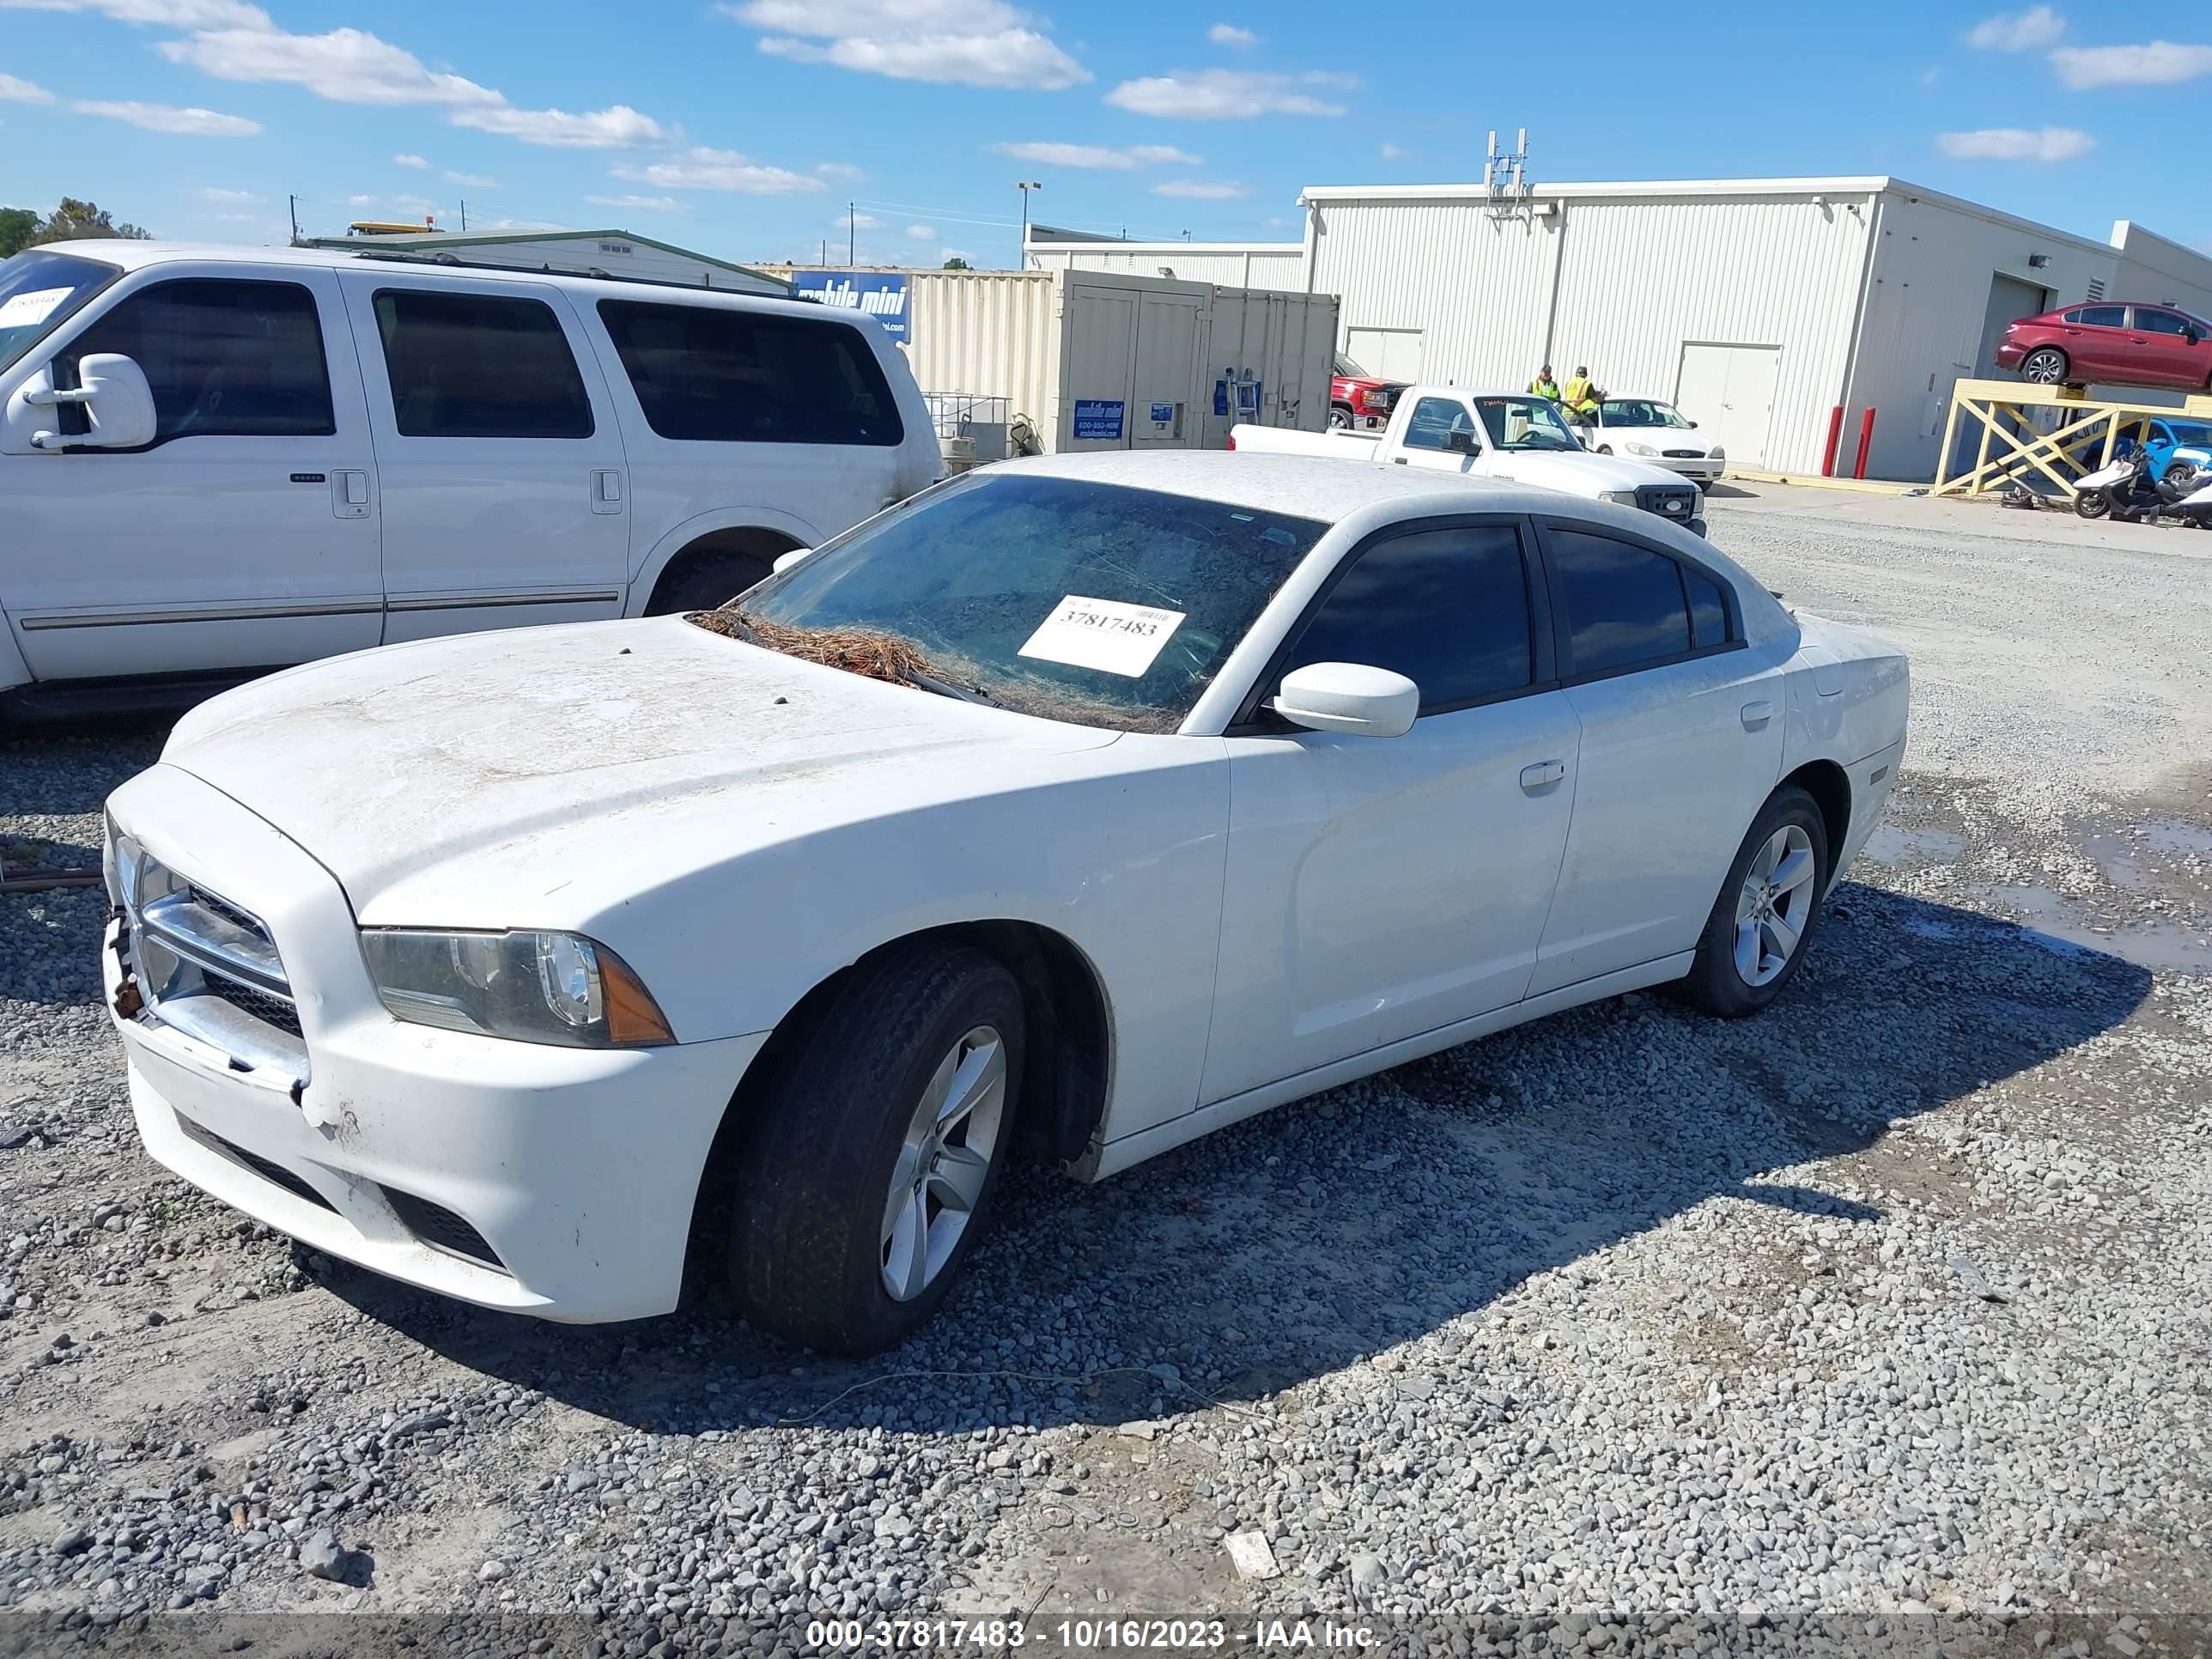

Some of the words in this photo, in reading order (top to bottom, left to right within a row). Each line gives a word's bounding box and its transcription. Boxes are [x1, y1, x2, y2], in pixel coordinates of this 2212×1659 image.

[860, 285, 907, 315] mini
[1076, 402, 1105, 418] mobile
[1104, 404, 1123, 418] mini
[1060, 611, 1158, 636] 37817483
